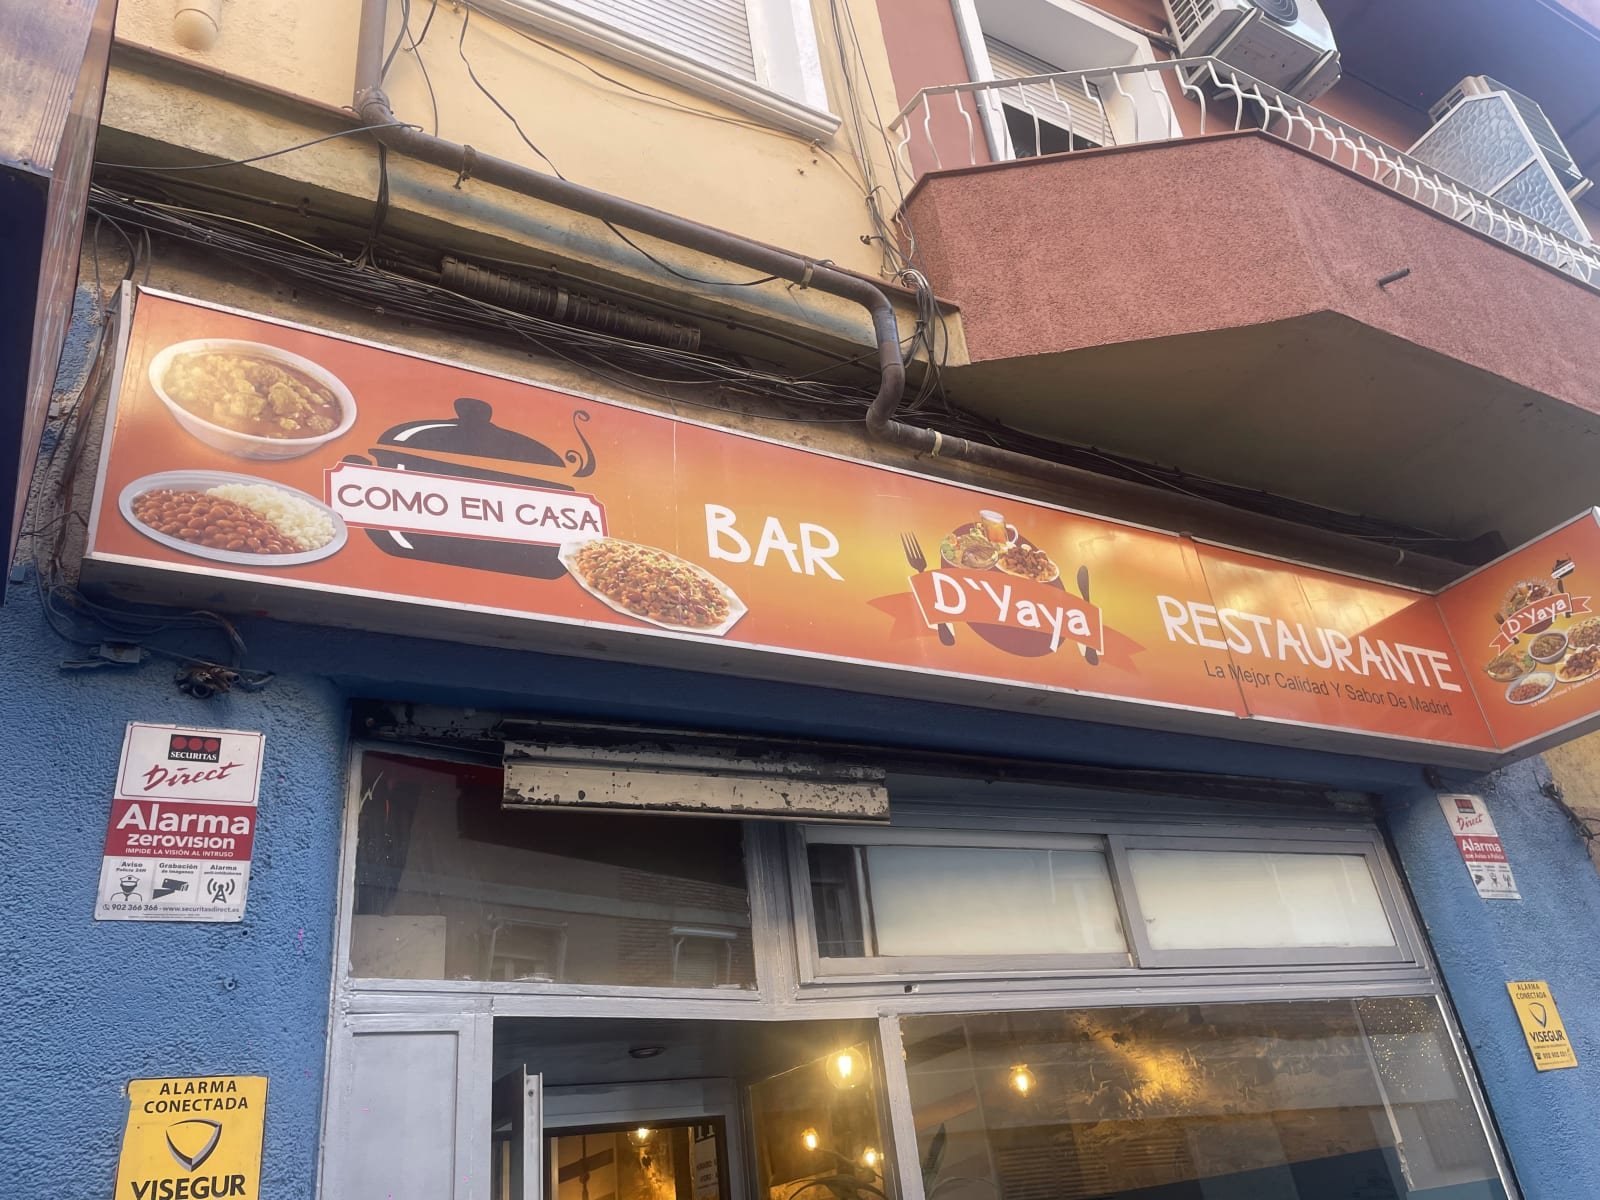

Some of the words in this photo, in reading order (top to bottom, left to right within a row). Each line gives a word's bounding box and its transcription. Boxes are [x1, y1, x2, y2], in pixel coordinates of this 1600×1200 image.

[337, 483, 448, 515] COMO
[461, 498, 504, 524] EN
[515, 503, 600, 534] CASA
[704, 503, 844, 582] BAR
[1156, 595, 1462, 692] RESTAURANTE
[1203, 660, 1226, 679] La
[1228, 663, 1270, 688] Mejor
[1274, 673, 1330, 697] Calidad
[1330, 681, 1343, 698] Y
[1345, 684, 1385, 706] Sabor
[1387, 692, 1407, 709] De
[1408, 695, 1453, 716] Madrid
[170, 751, 217, 761] SECURITAS
[142, 761, 245, 791] Direct
[116, 803, 250, 835] Alarma
[1462, 839, 1501, 852] Alarma
[159, 862, 198, 870] Grabación
[111, 903, 127, 911] 902
[1529, 1030, 1565, 1042] VISEGUR
[160, 1080, 237, 1095] ALARMA
[144, 1097, 249, 1113] CONECTADA
[131, 1174, 246, 1200] VISEGUR
